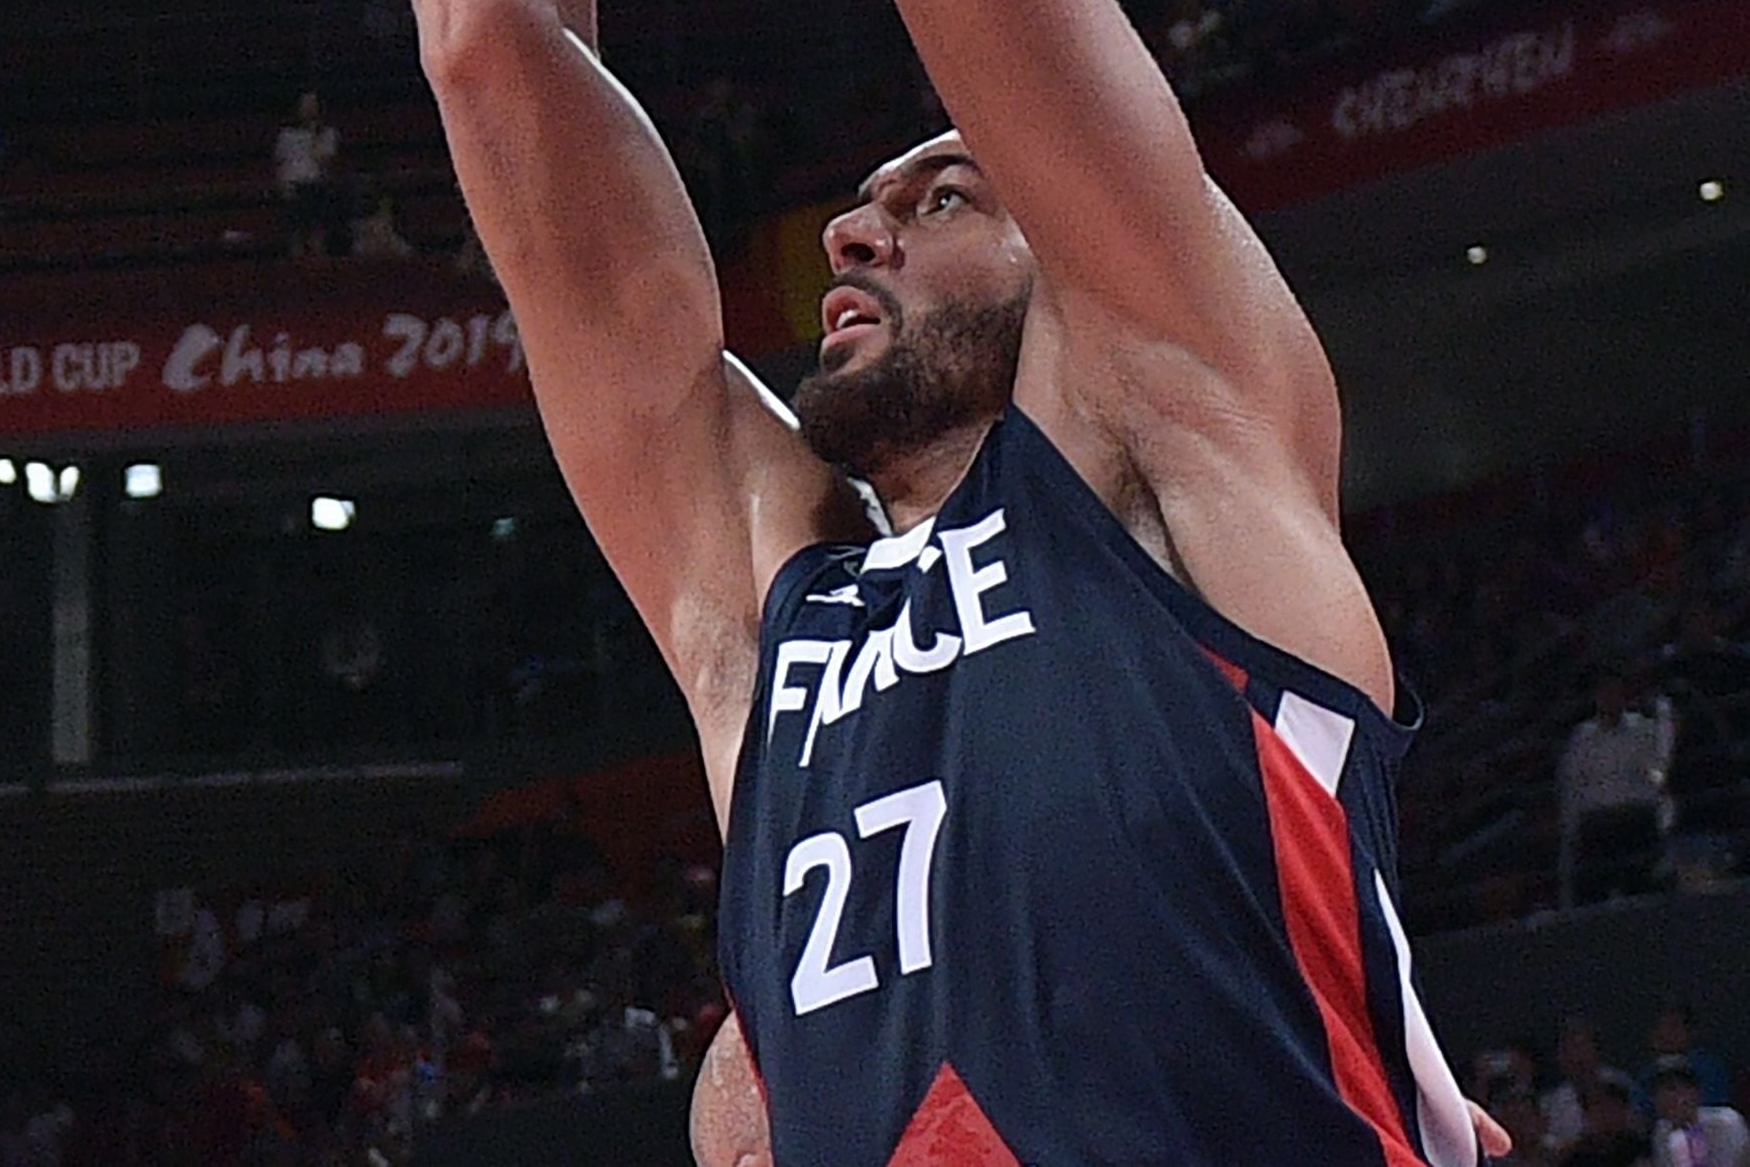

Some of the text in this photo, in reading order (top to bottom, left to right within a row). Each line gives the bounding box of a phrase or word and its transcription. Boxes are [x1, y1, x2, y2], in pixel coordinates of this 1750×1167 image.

[51, 339, 141, 392] CUP
[161, 309, 526, 393] China 2019
[781, 778, 948, 1017] 27
